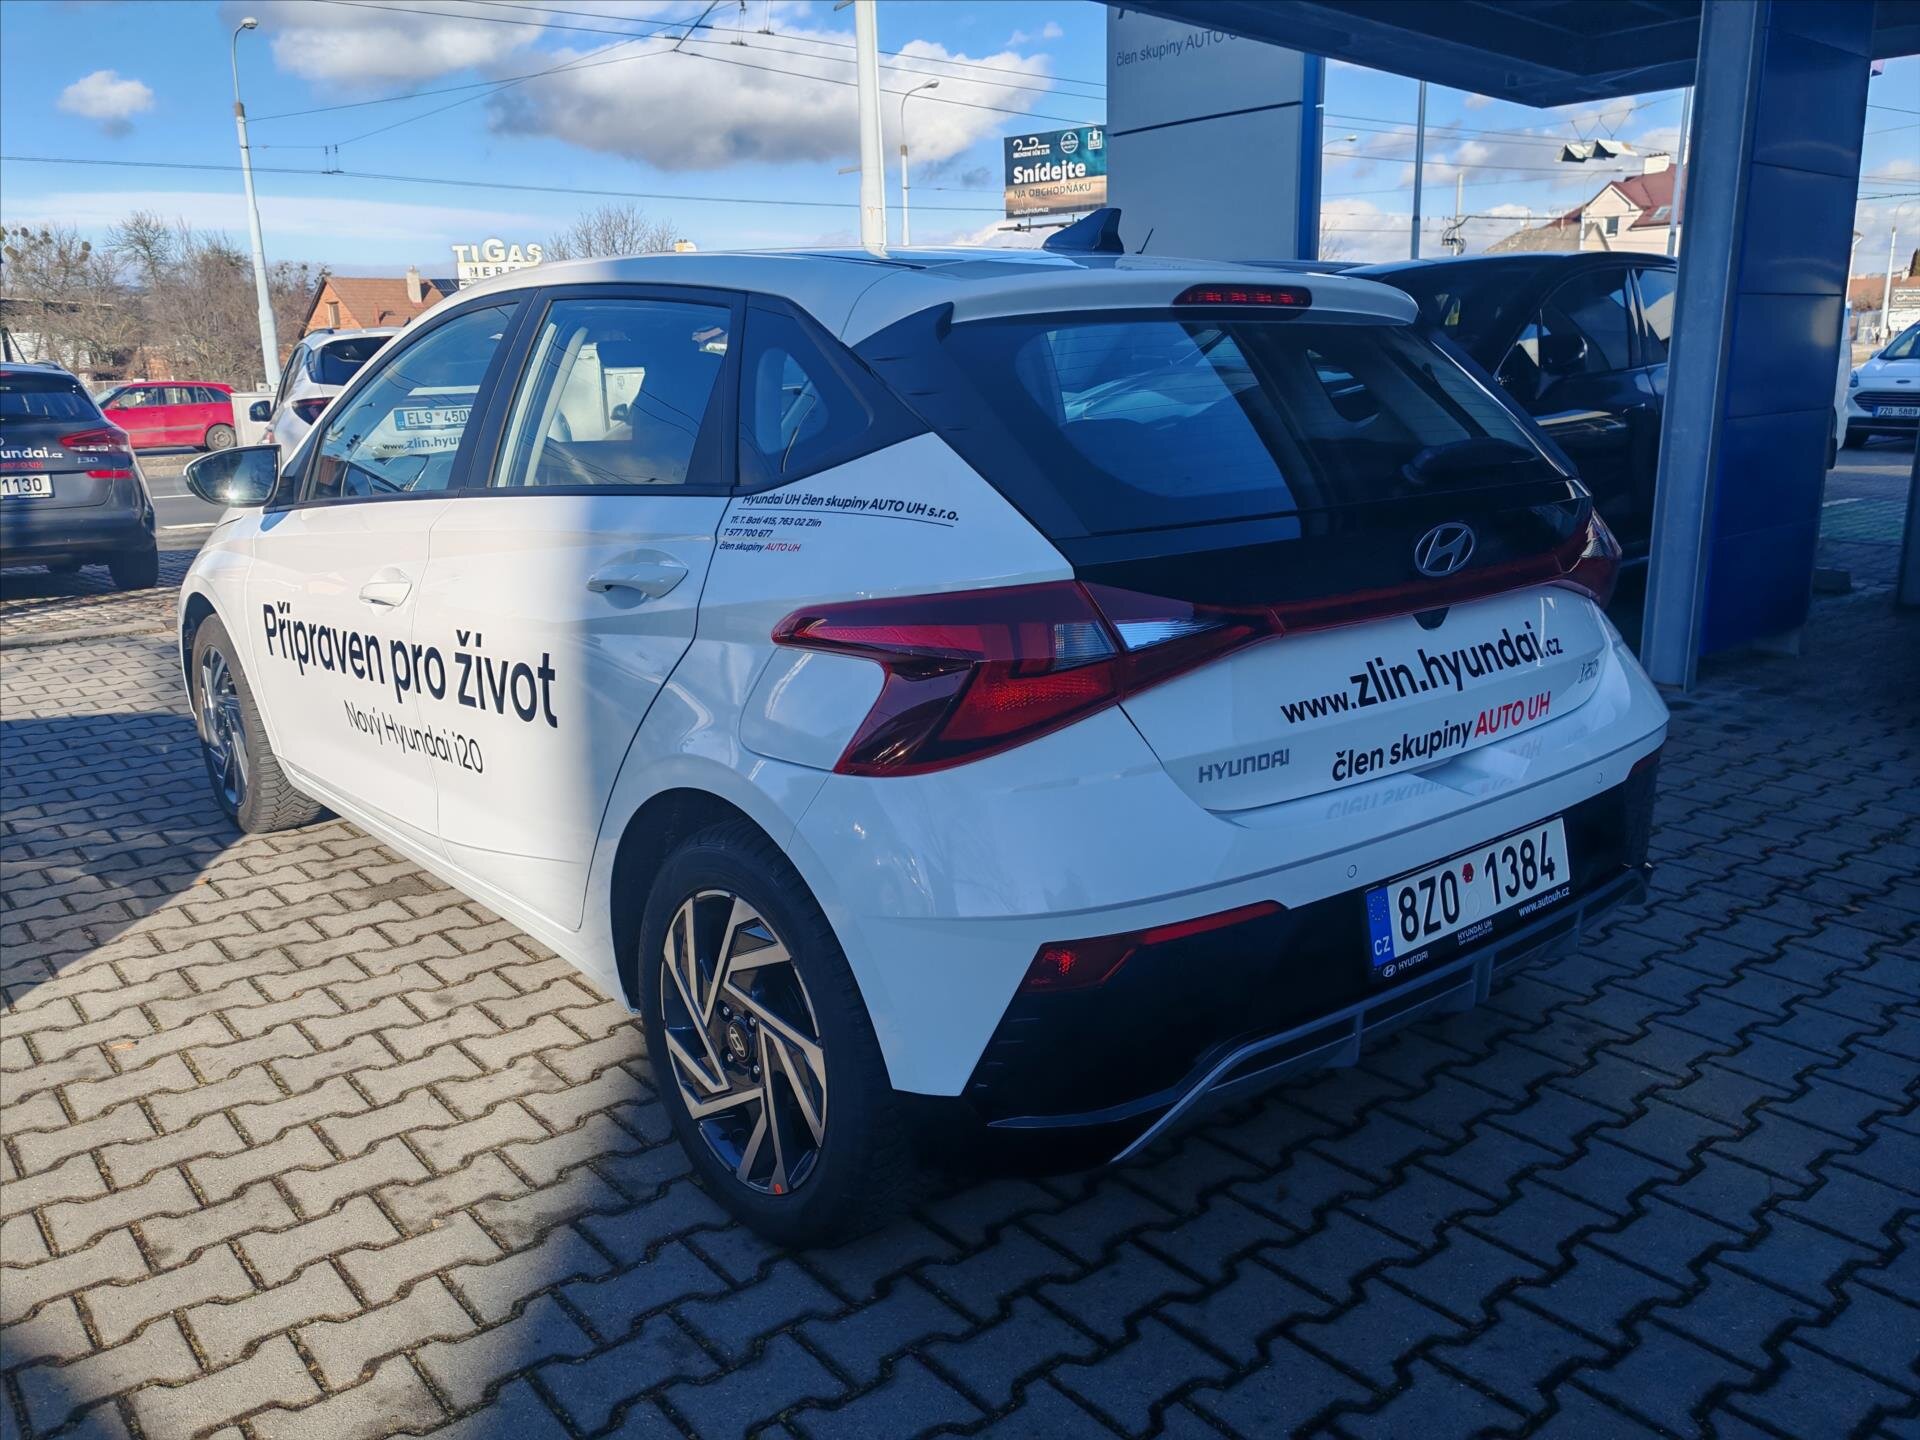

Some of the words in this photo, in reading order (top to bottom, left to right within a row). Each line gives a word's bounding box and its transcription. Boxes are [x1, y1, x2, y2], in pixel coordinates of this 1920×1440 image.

[1116, 51, 1137, 66] člen
[1140, 40, 1183, 61] skupiny
[1185, 31, 1224, 50] AUTO
[1013, 160, 1086, 184] Snídejte
[1014, 190, 1026, 199] NA
[452, 238, 543, 264] TIGAS
[407, 412, 433, 425] EL9
[2, 478, 42, 493] 1130
[743, 493, 784, 506] Hyundai
[785, 494, 801, 505] UH
[801, 493, 824, 506] člen
[825, 495, 868, 511] skupiny
[870, 498, 904, 512] AUTO
[906, 502, 927, 516] UH
[927, 504, 960, 522] s.r.o.
[742, 529, 758, 537] 700
[762, 516, 777, 527] 415,
[778, 517, 793, 526] 763
[794, 518, 806, 526] 02
[719, 541, 735, 550] člen
[735, 542, 764, 553] skupiny
[764, 543, 788, 552] AUTO
[788, 544, 801, 552] UH
[262, 601, 386, 685] Připraven
[389, 639, 447, 704] pro
[454, 629, 559, 729] život
[1280, 620, 1564, 724] www.zlin.hyundai.cz
[343, 699, 384, 746] Nový
[380, 711, 454, 764] Hyundai
[451, 732, 484, 775] i20
[1332, 748, 1385, 782] člen
[1389, 719, 1474, 766] skupiny
[1473, 700, 1526, 739] AUTO
[1526, 690, 1553, 718] UH
[1198, 748, 1291, 784] HYUNDAI
[1483, 830, 1556, 906] 1384
[1518, 886, 1571, 917] www.autouh.cz
[1374, 935, 1392, 956] CZ
[1398, 951, 1429, 970] HYUNDAI
